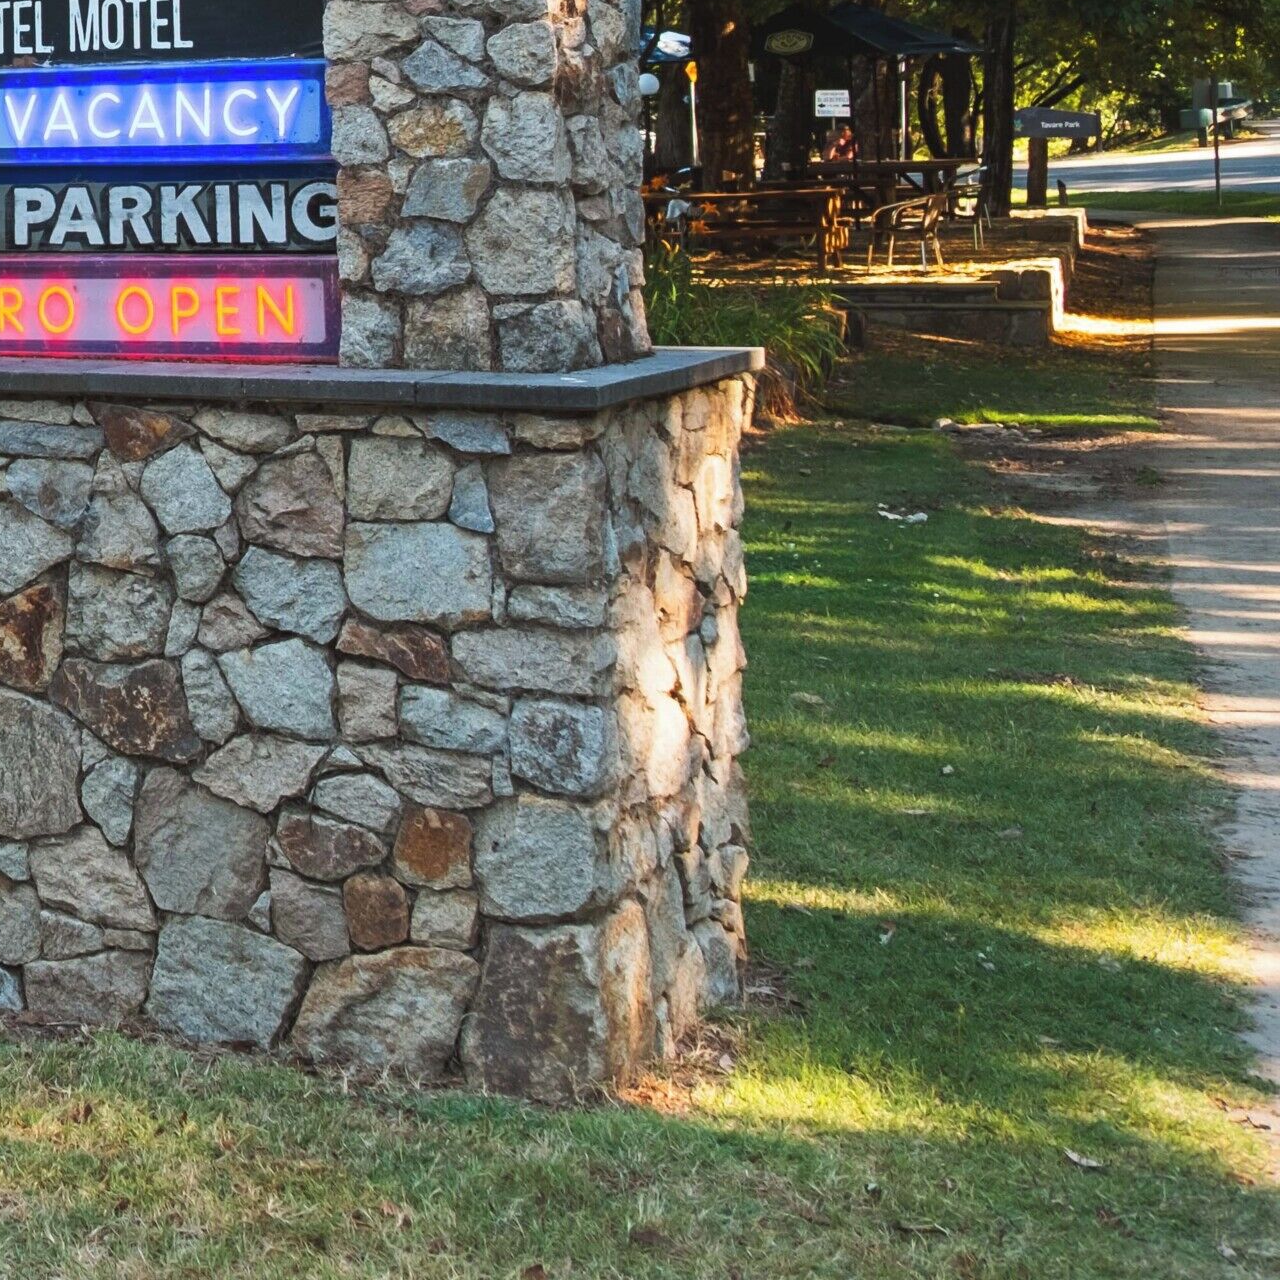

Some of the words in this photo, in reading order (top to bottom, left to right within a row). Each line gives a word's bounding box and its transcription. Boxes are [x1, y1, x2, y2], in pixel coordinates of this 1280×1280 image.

[4, 85, 302, 141] VACANCY
[12, 182, 338, 246] PARKING
[115, 284, 296, 336] OPEN
